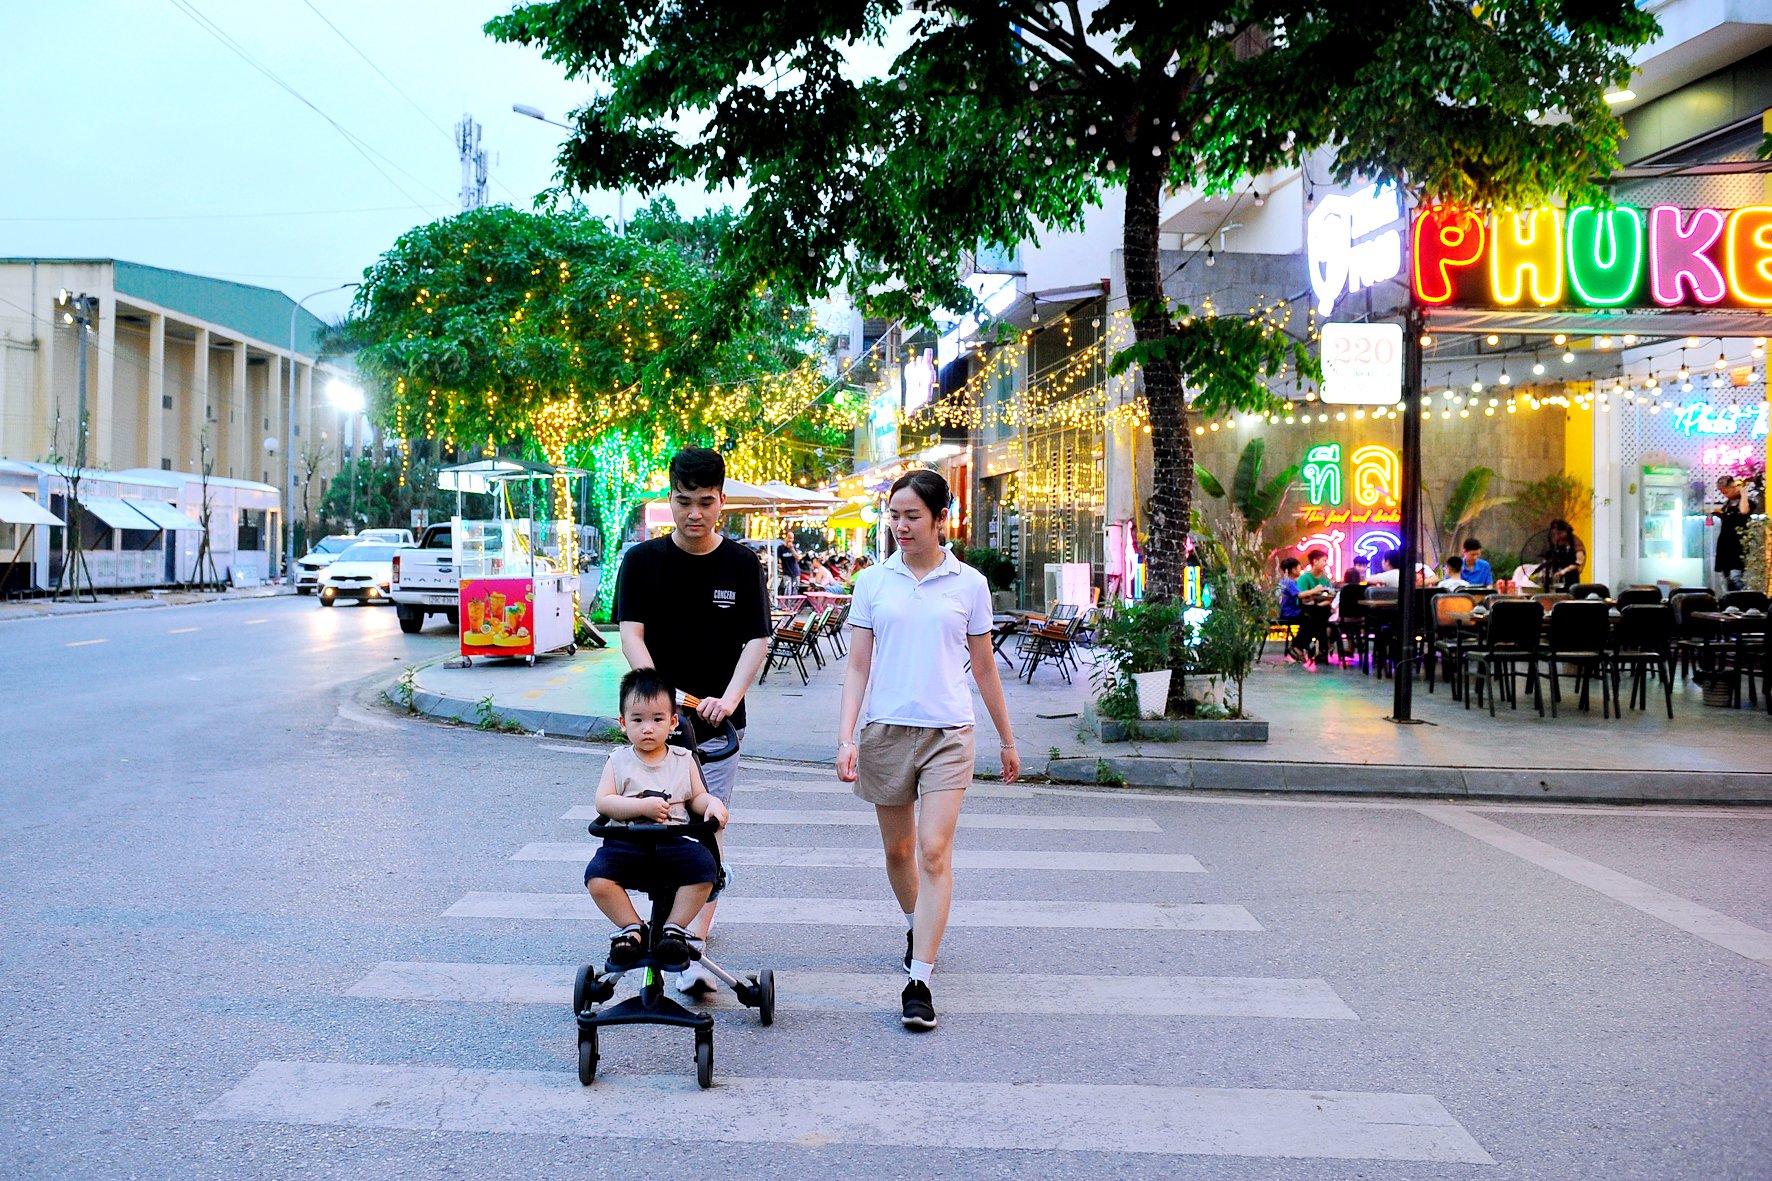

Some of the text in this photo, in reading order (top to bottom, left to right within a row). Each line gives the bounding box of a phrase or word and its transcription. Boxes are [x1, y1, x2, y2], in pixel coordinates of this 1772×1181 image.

[1333, 337, 1395, 365] 220
[1325, 509, 1351, 526] food
[1351, 509, 1372, 523] and
